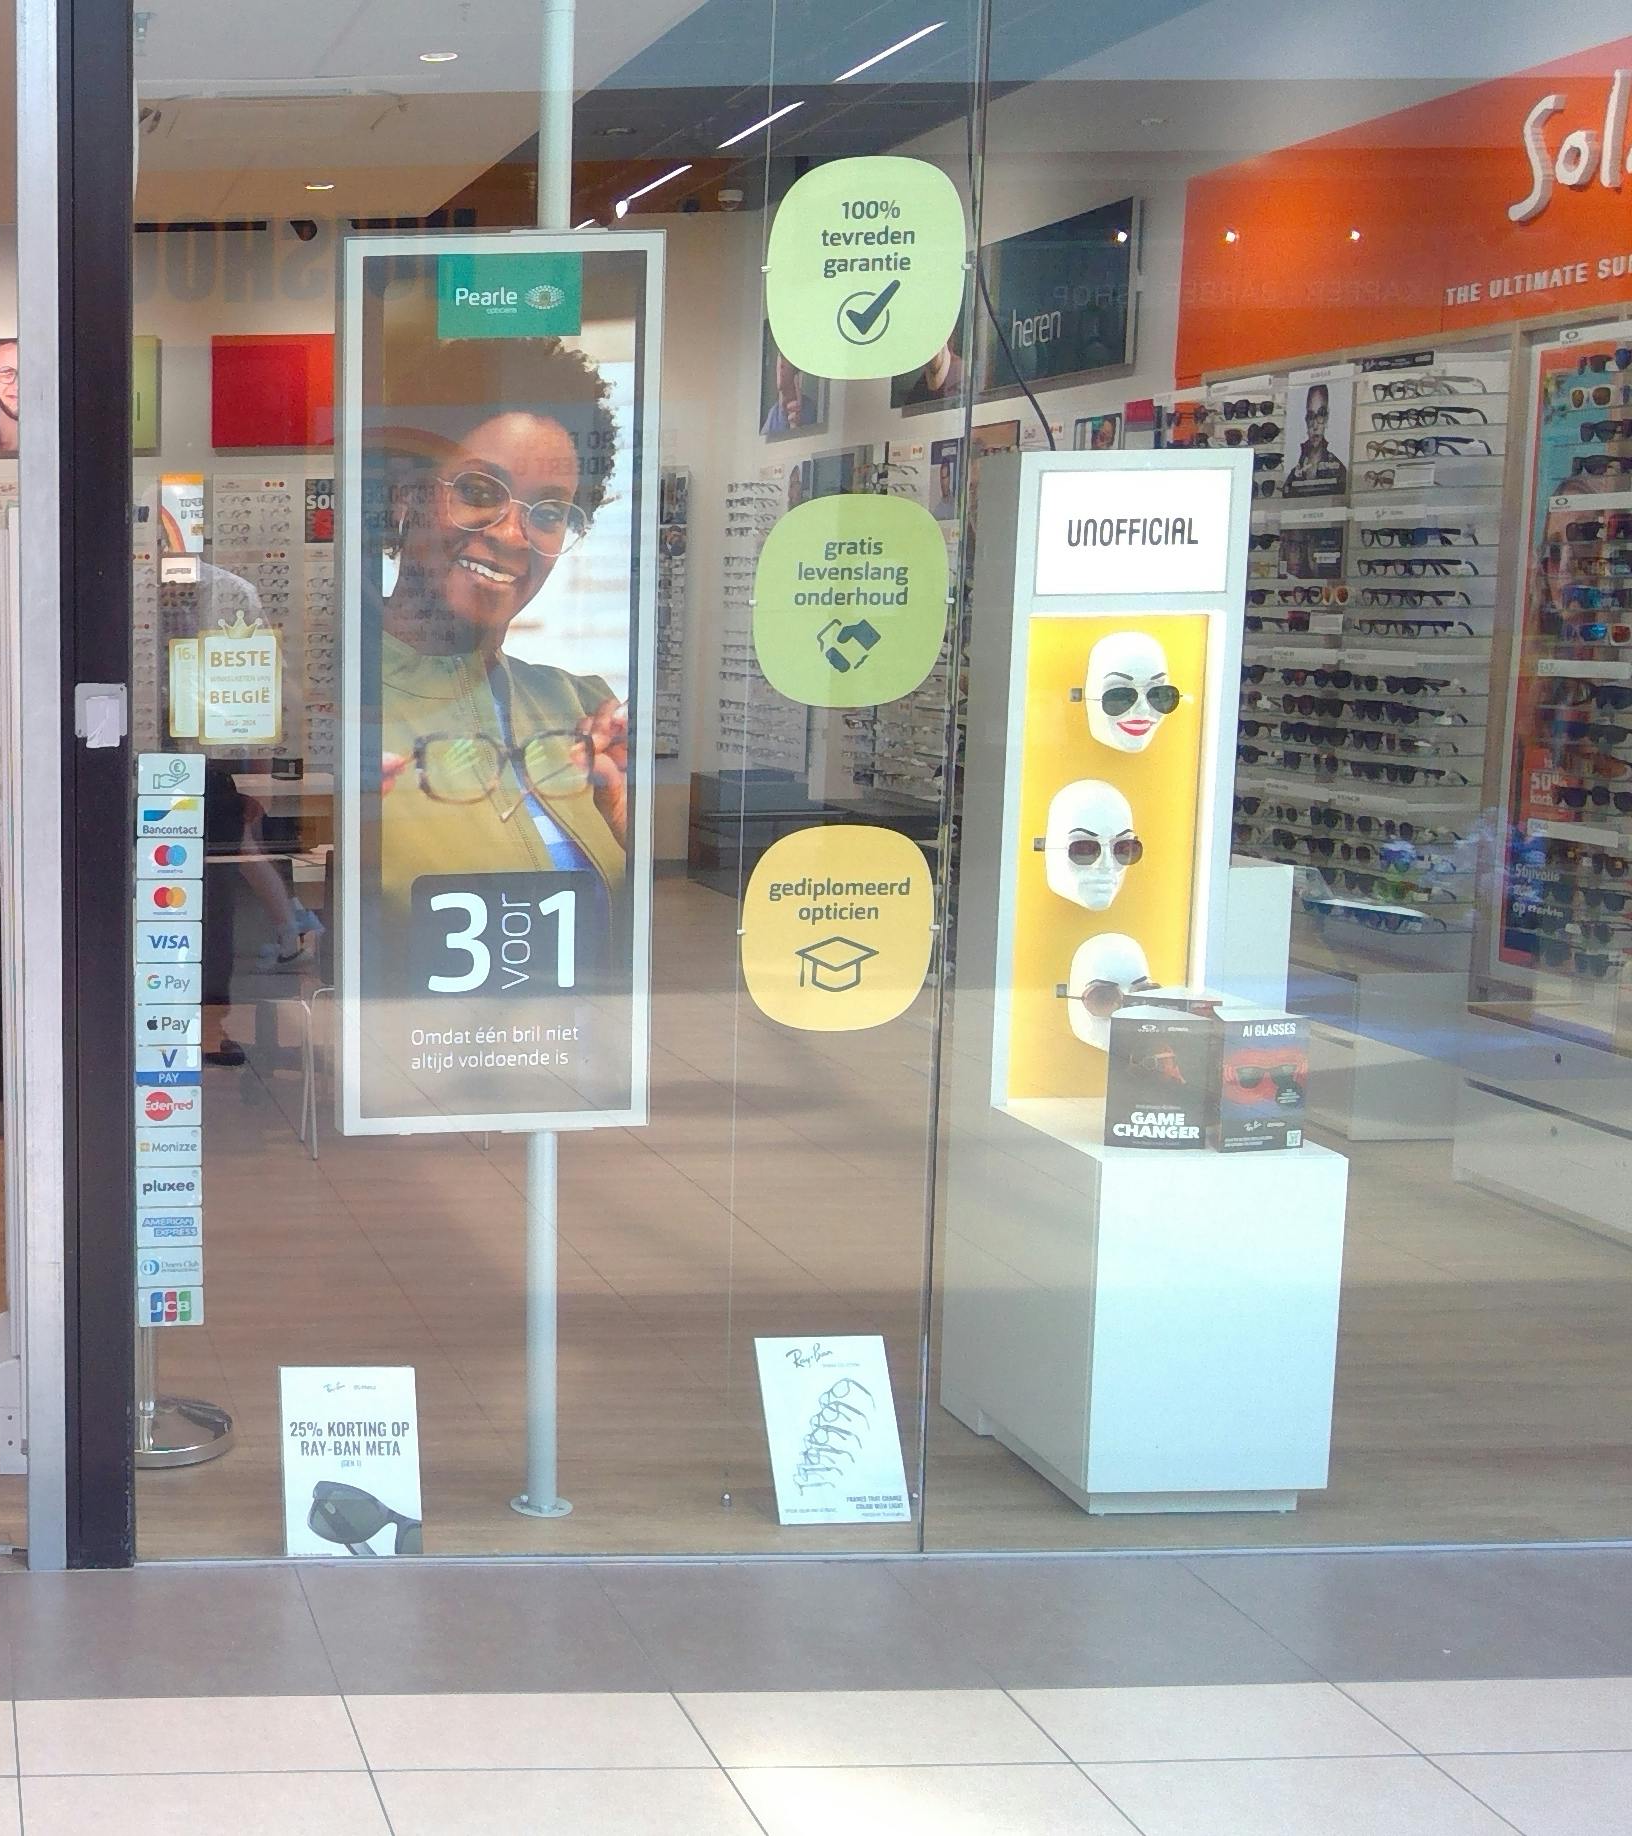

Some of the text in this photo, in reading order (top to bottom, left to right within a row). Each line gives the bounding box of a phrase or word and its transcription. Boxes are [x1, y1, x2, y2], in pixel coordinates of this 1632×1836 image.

[1508, 69, 1632, 223] Sol
[841, 200, 901, 220] 100%
[821, 227, 915, 247] tevreden
[823, 253, 911, 279] garantie
[1446, 283, 1481, 306] THE
[1489, 263, 1589, 299] ULTIMATE
[455, 286, 517, 306] Pearle
[1011, 309, 1061, 349] heren
[1068, 518, 1199, 547] UNOFFICIAL
[824, 537, 883, 561] gratis
[798, 561, 909, 585] levenslang
[794, 587, 908, 606] onderhoud
[210, 651, 271, 667] BESTE
[210, 687, 271, 704] BELGIË
[143, 825, 198, 835] Bancontact
[769, 877, 911, 901] gediplomeerd
[799, 903, 879, 925] opticien
[148, 935, 190, 949] VISA
[428, 890, 576, 993] 3 voor 1
[146, 975, 190, 992] G Pay
[162, 1017, 190, 1034] Pay
[1243, 1023, 1296, 1037] AI GLASSES
[411, 1024, 579, 1046] Omdat één bril niet
[160, 1049, 178, 1068] V
[411, 1050, 569, 1073] altijd voldoende is
[158, 1073, 180, 1083] PAY
[144, 1099, 193, 1111] Edenred
[1131, 1112, 1185, 1125] GAME
[1113, 1124, 1199, 1138] CHANGER
[152, 1141, 197, 1153] Monizze
[143, 1180, 195, 1195] pluxee
[143, 1217, 194, 1227] AMERICAN
[155, 1227, 197, 1237] EXPRESS
[290, 1422, 410, 1437] 25% KORTING OP
[300, 1441, 401, 1456] RAY-BAN META
